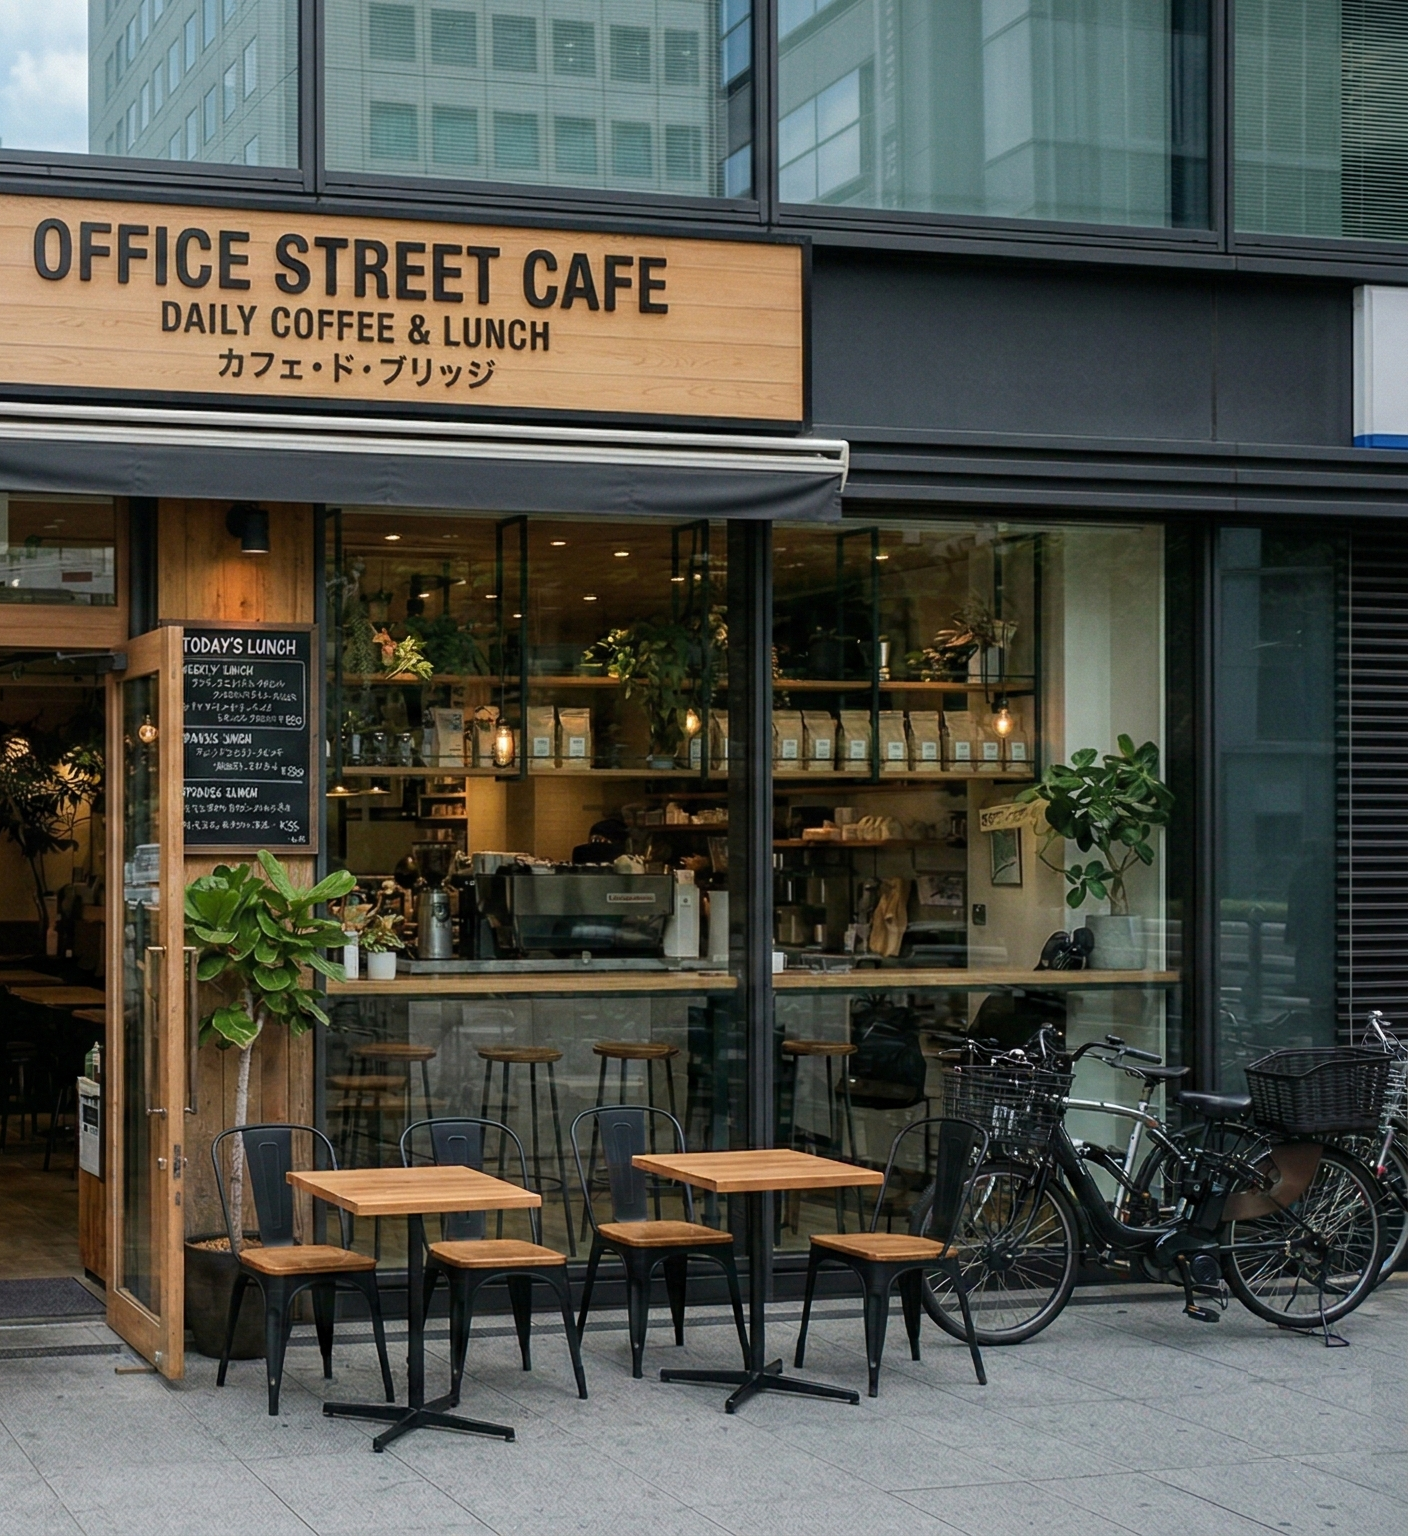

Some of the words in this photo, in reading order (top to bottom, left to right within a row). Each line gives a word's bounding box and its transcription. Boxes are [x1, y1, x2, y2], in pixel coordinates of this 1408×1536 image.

[33, 217, 252, 291] OFFICE
[275, 233, 501, 306] STREET
[523, 248, 669, 315] CAFE
[161, 300, 258, 336] DAILY
[270, 306, 395, 344] COFFEE
[407, 313, 431, 346] &
[443, 315, 550, 351] LUNCH
[218, 347, 496, 390] カフェ・ド・ブリッジ
[183, 636, 244, 655] TODAY'S
[247, 638, 297, 656] LUNCH
